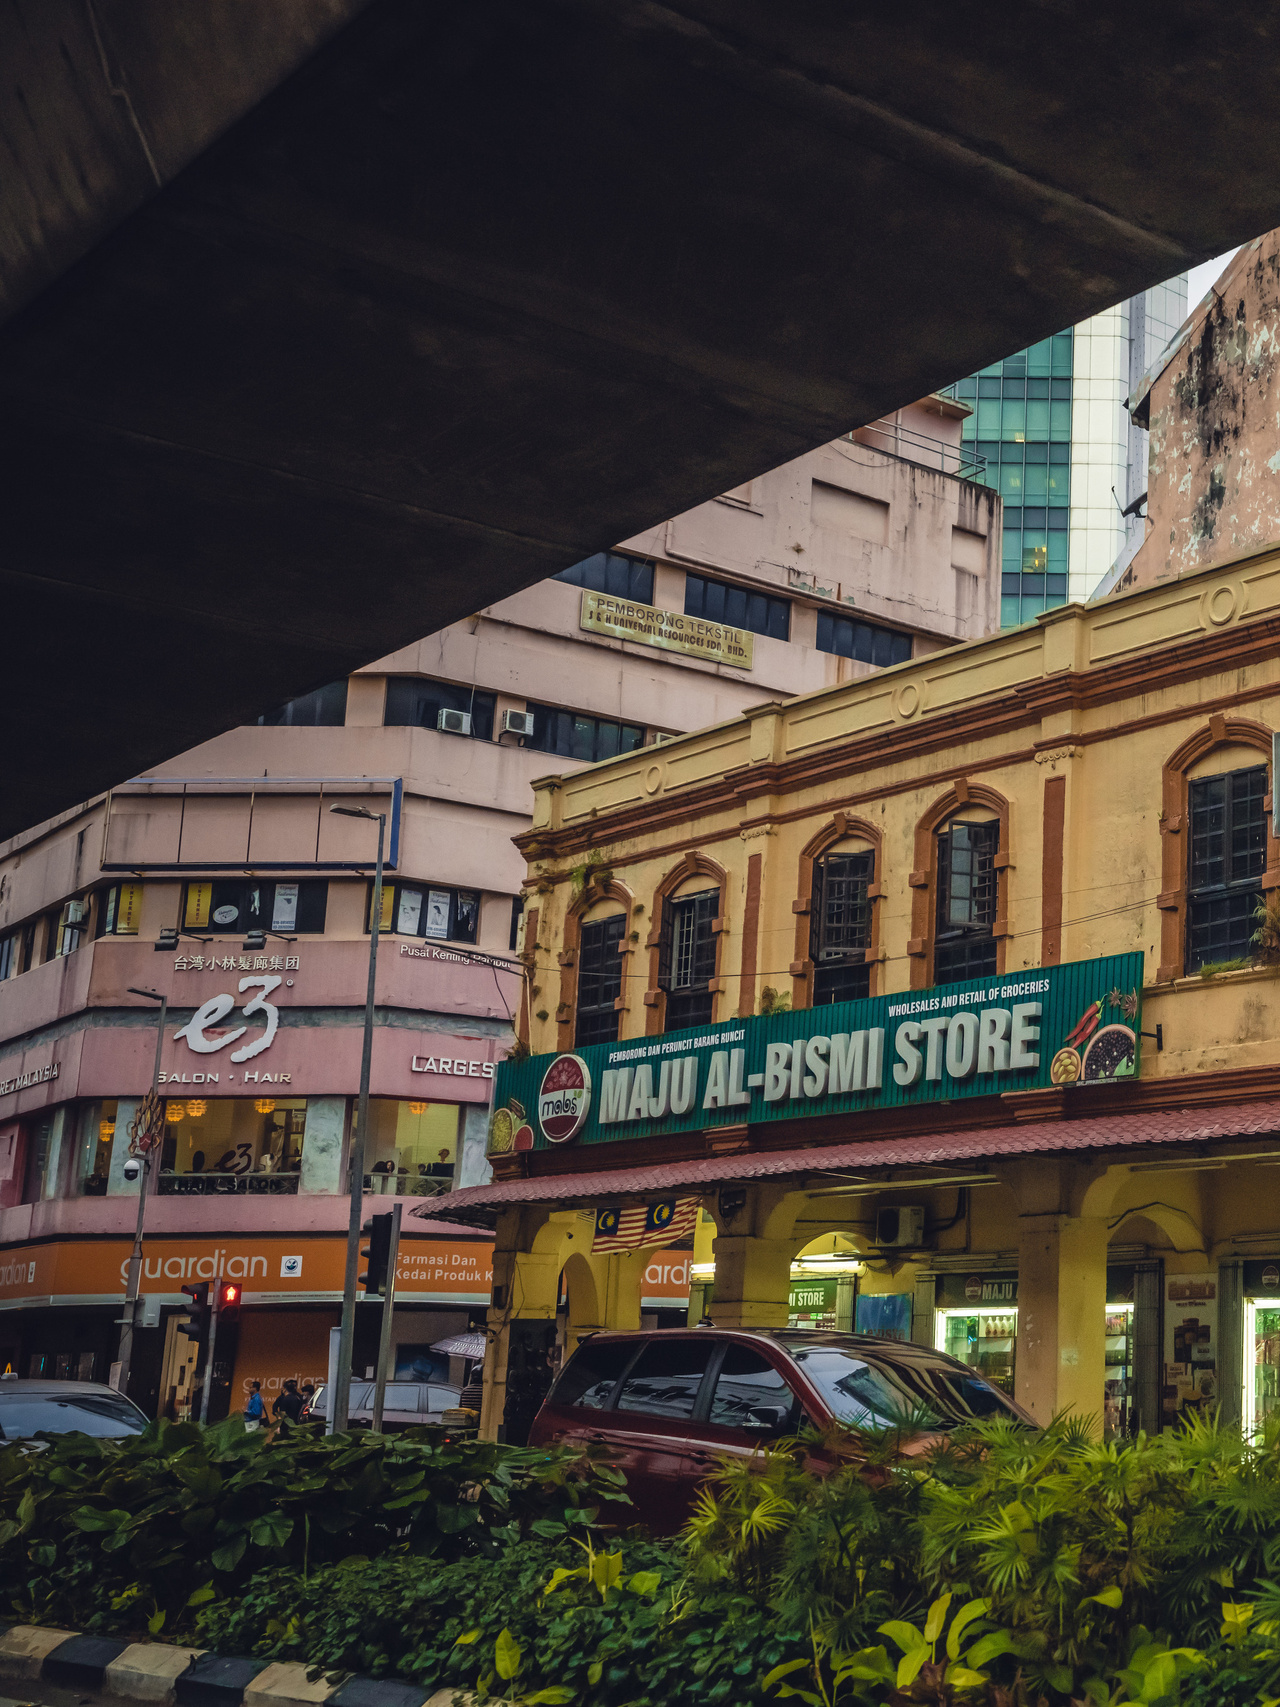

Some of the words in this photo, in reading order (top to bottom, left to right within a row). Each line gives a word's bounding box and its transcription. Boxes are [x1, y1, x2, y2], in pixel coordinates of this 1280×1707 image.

[597, 598, 684, 629] PEMBORONG
[689, 621, 741, 644] TEKSTIL
[588, 610, 594, 620] S
[596, 612, 602, 622] &
[614, 616, 656, 636] UNIVERSAL
[658, 627, 704, 647] RESOURCES
[727, 645, 748, 658] BHD.
[400, 944, 429, 958] Pusat
[888, 998, 940, 1017] WHOLESALES
[941, 994, 958, 1009] AND
[959, 990, 987, 1006] RETAIL
[988, 987, 1000, 1000] OF
[1001, 978, 1050, 998] GROCERIES
[609, 1047, 647, 1063] PEMBORONG
[648, 1044, 661, 1057] DAN
[662, 1038, 693, 1054] PERUNCIT
[694, 1033, 720, 1049] BARANG
[721, 1029, 746, 1044] RUNCIT
[599, 1056, 699, 1123] MAJU
[703, 1027, 886, 1109] AL-BISMI
[893, 1001, 1043, 1086] STORE
[16, 1063, 59, 1089] MALAYSIA
[158, 1071, 219, 1084] SALON
[244, 1071, 292, 1084] HAIR
[397, 1253, 448, 1265] Farmasi
[451, 1254, 476, 1266] Dan
[396, 1268, 431, 1280] Kedai
[435, 1269, 481, 1281] Produk
[798, 1291, 825, 1307] STORE
[982, 1283, 1013, 1300] MAJU
